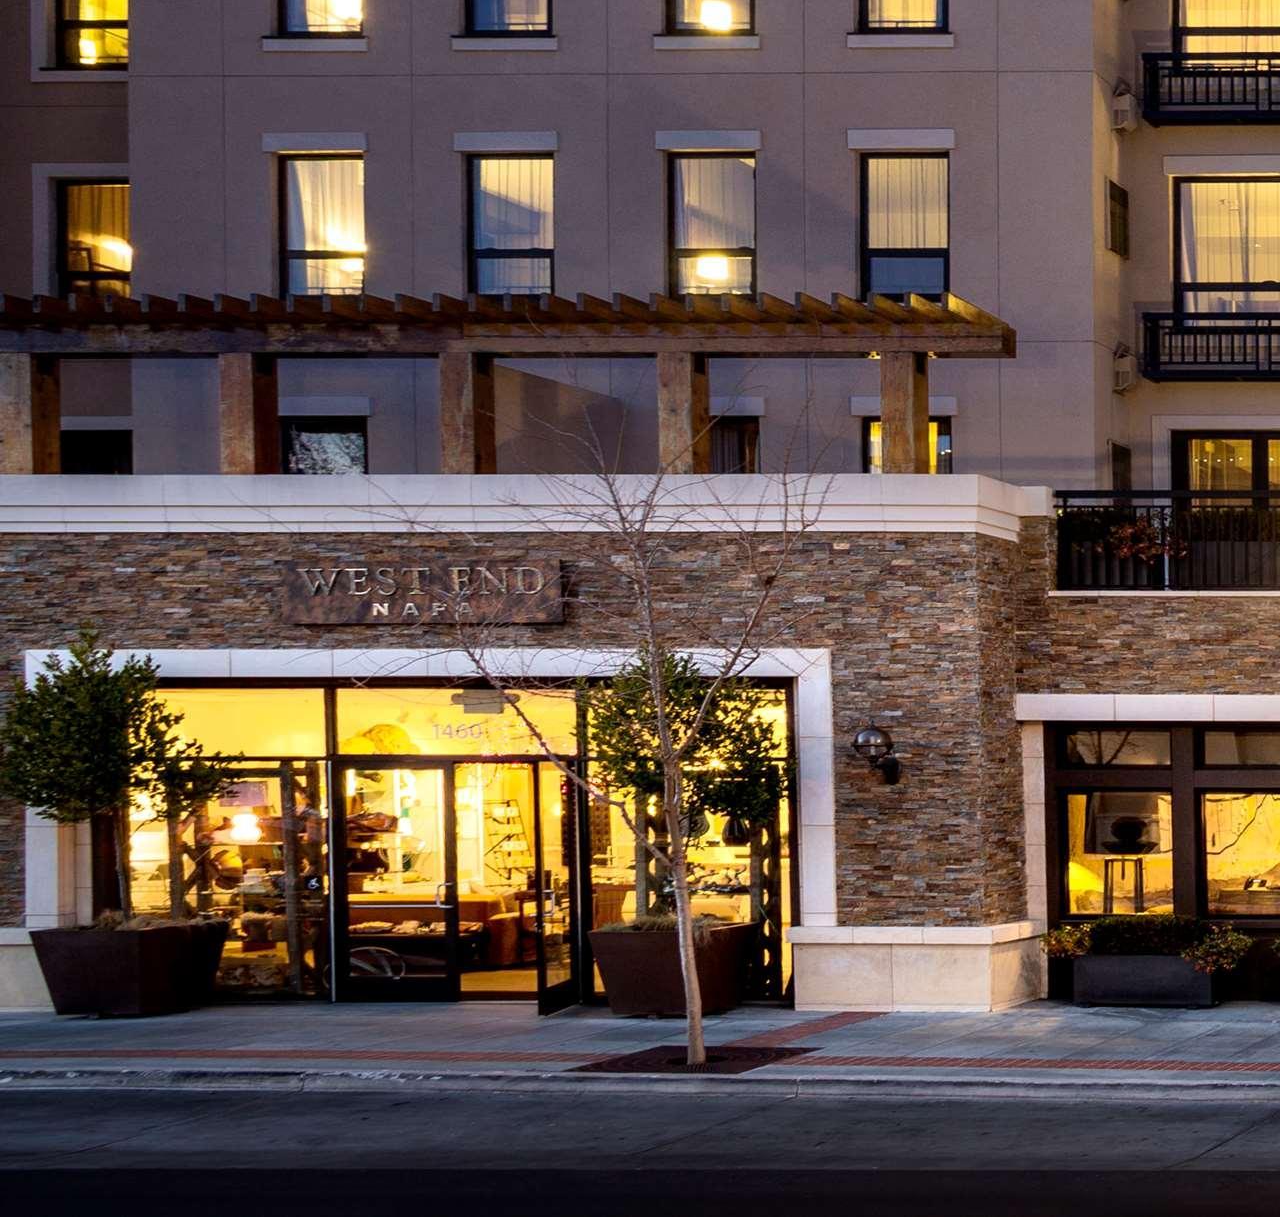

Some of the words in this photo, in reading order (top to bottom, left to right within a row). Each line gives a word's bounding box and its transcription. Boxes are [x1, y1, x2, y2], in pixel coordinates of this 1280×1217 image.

[296, 567, 430, 596] WEST
[449, 566, 546, 596] END
[372, 602, 475, 617] NAPA
[432, 723, 484, 740] 1460
